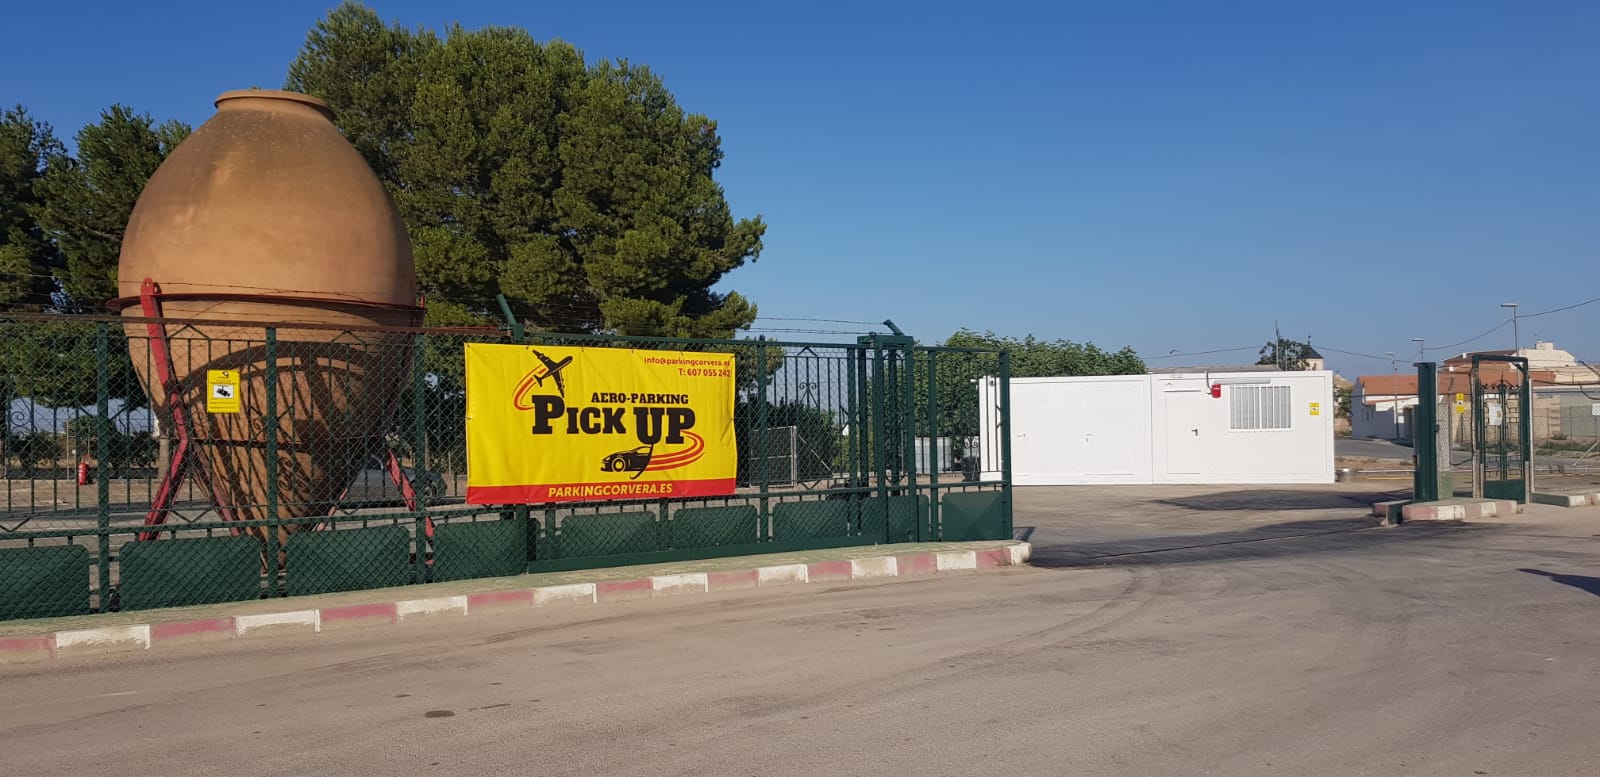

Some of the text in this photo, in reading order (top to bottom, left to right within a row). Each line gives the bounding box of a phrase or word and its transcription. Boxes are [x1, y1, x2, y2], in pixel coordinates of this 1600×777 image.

[678, 368, 731, 377] T: 607 055 242
[591, 392, 689, 405] AERO-PARKING
[531, 394, 696, 445] PICK UP
[548, 483, 673, 498] PARKINGCORVERA.ES
